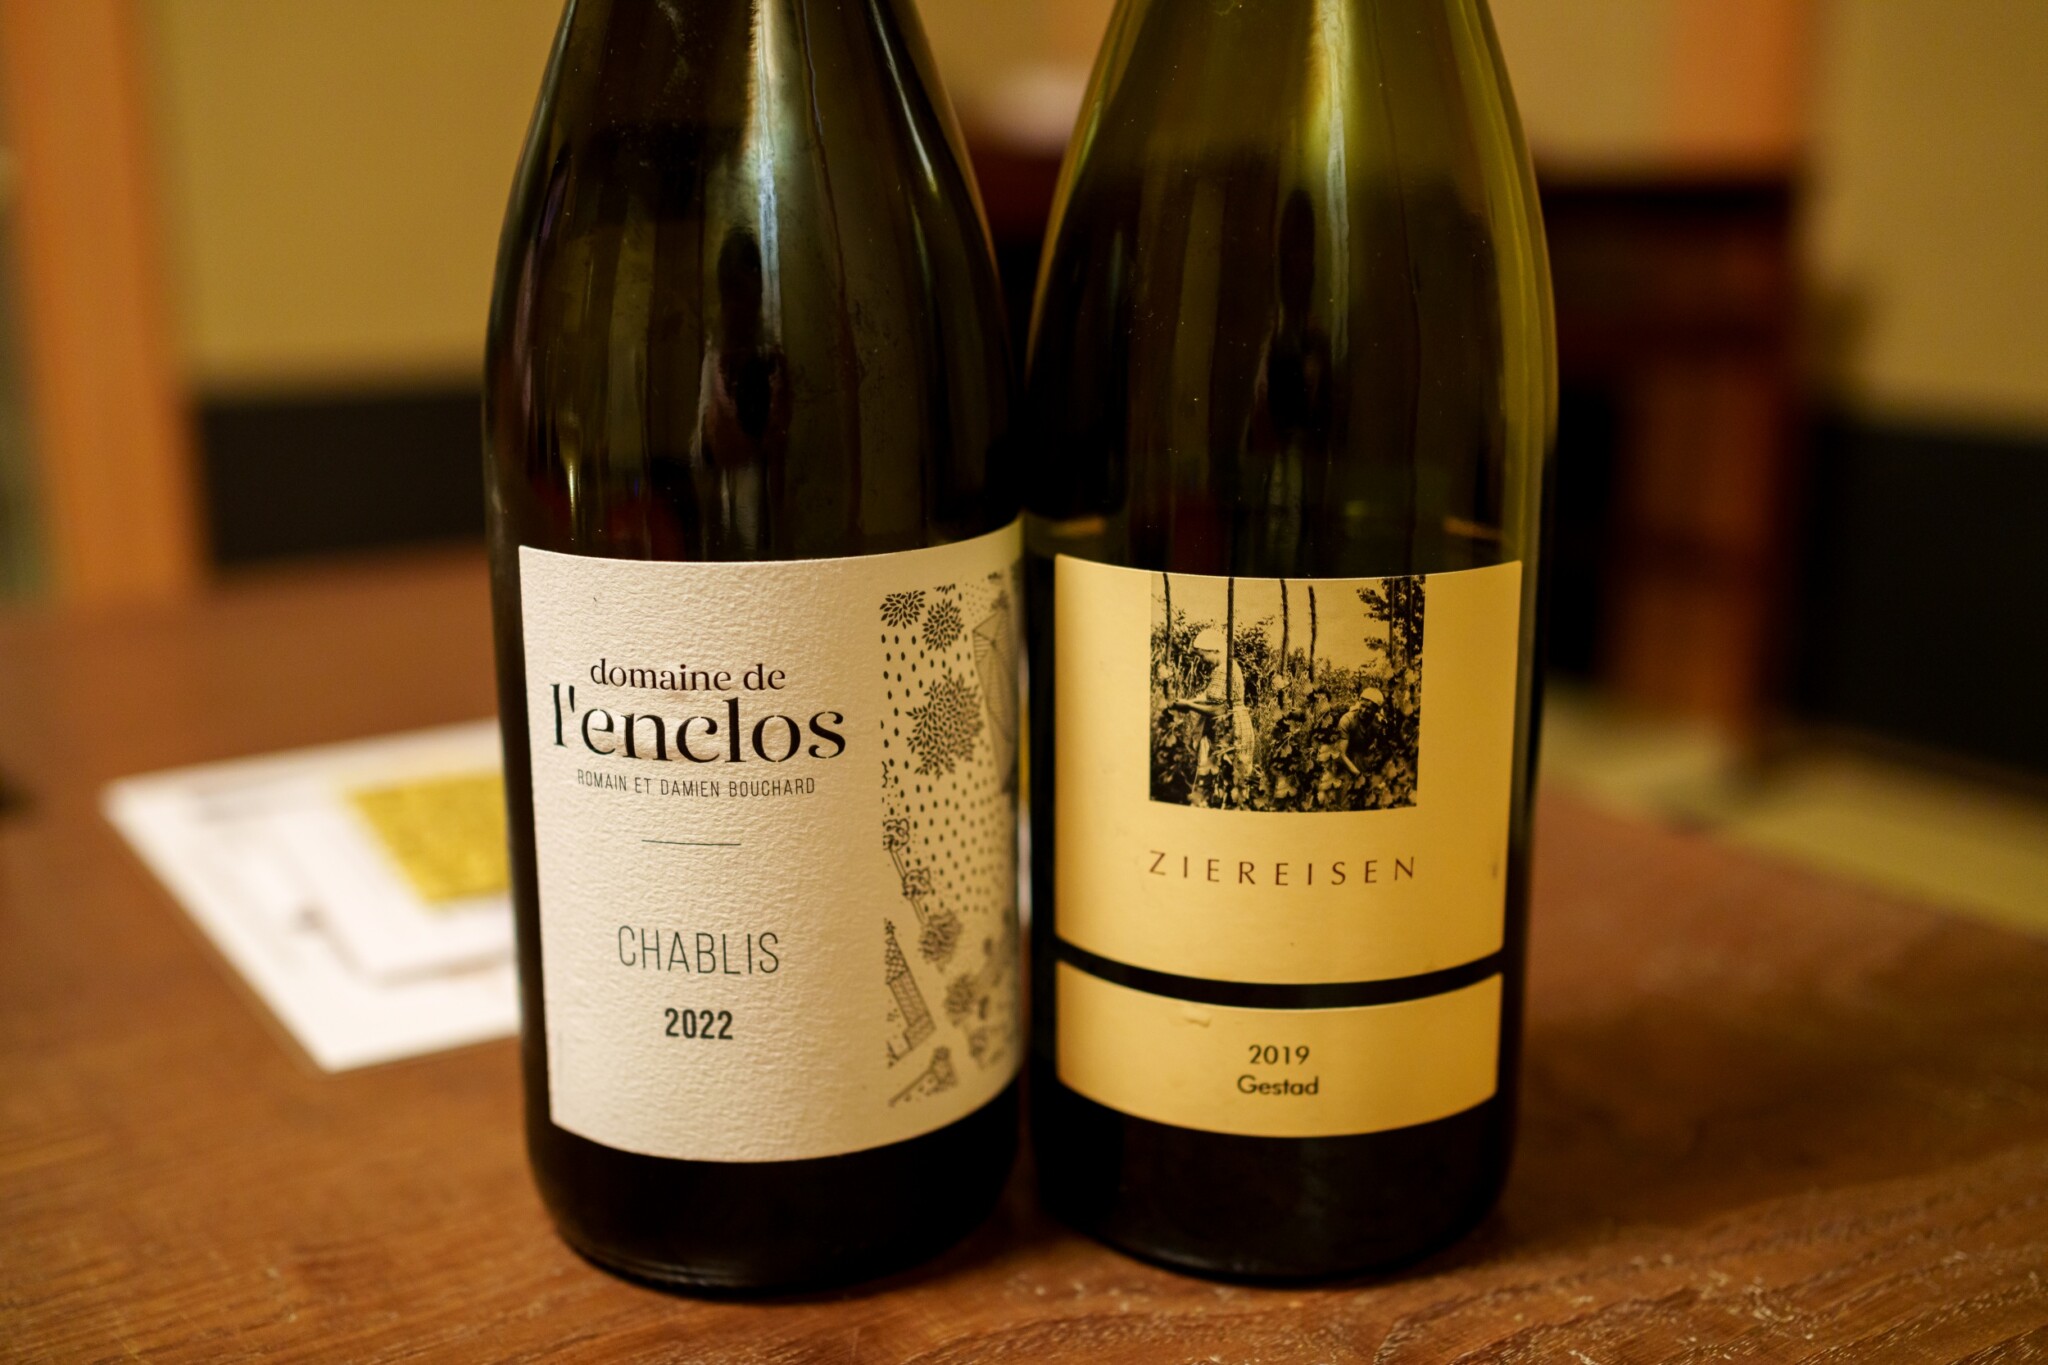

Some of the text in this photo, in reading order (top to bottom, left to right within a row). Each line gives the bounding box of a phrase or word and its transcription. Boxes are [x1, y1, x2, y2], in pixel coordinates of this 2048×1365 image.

[590, 658, 786, 691] domaine de
[550, 683, 846, 763] l'enclos
[577, 768, 816, 798] ROMAIN ET DAMIEN BOUCHARD
[1148, 850, 1416, 886] ZIEREISEN
[618, 925, 779, 975] CHABLIS
[664, 1007, 734, 1041] 2022
[1248, 1044, 1310, 1066] 2019
[1237, 1074, 1320, 1096] Gestad
